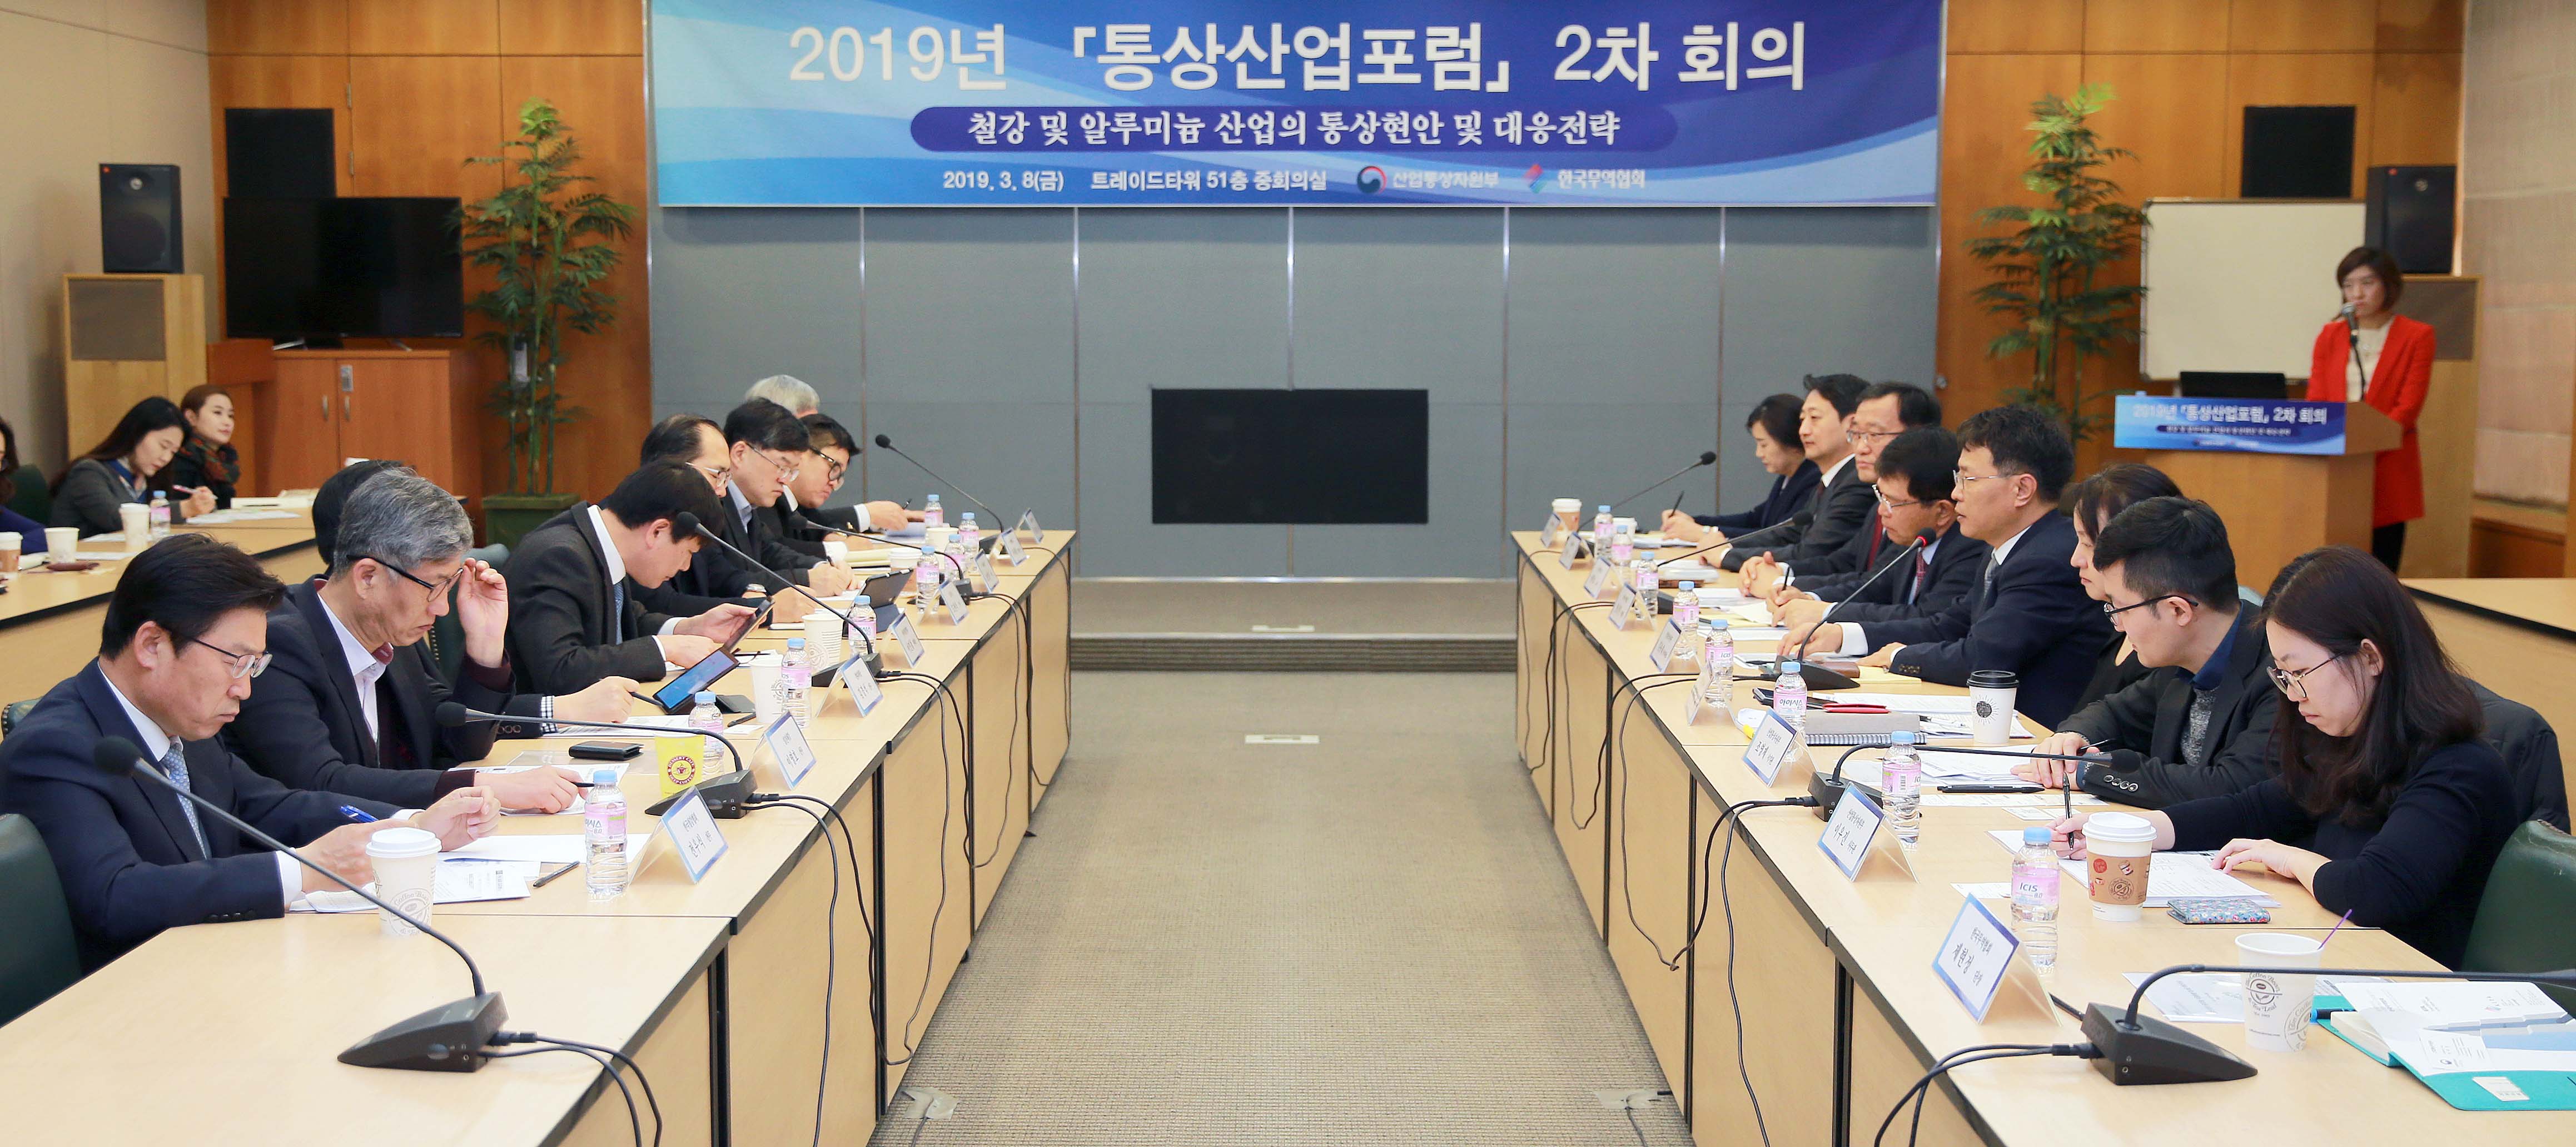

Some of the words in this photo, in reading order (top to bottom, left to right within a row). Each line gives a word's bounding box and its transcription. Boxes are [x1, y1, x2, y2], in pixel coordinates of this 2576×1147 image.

[789, 24, 1007, 91] 2019년
[1072, 22, 1510, 93] 「통상산업포럼」
[1553, 22, 1659, 91] 2차
[1677, 21, 1806, 91] 회의
[967, 112, 1030, 146] 철강
[1040, 112, 1068, 147] 및
[1078, 112, 1206, 146] 알루미늄
[1213, 112, 1307, 146] 산업의
[1315, 111, 1445, 146] 통상현안
[1454, 111, 1483, 146] 및
[1494, 110, 1622, 146] 대응전략
[943, 170, 995, 191] 2019.
[999, 171, 1017, 191] 3.
[1021, 169, 1065, 192] 8(금)
[1090, 169, 1201, 192] 트레이드타워
[1206, 169, 1249, 191] 51층
[1253, 169, 1328, 192] 중회의실
[1391, 170, 1500, 190] 산업통상자원부
[1557, 168, 1647, 190] 한국무역협회
[2132, 404, 2178, 421] 2019년
[2272, 406, 2297, 424] 2차
[2297, 407, 2328, 425] 회의
[1833, 822, 1851, 846] 이우진
[2019, 882, 2038, 892] ICIS
